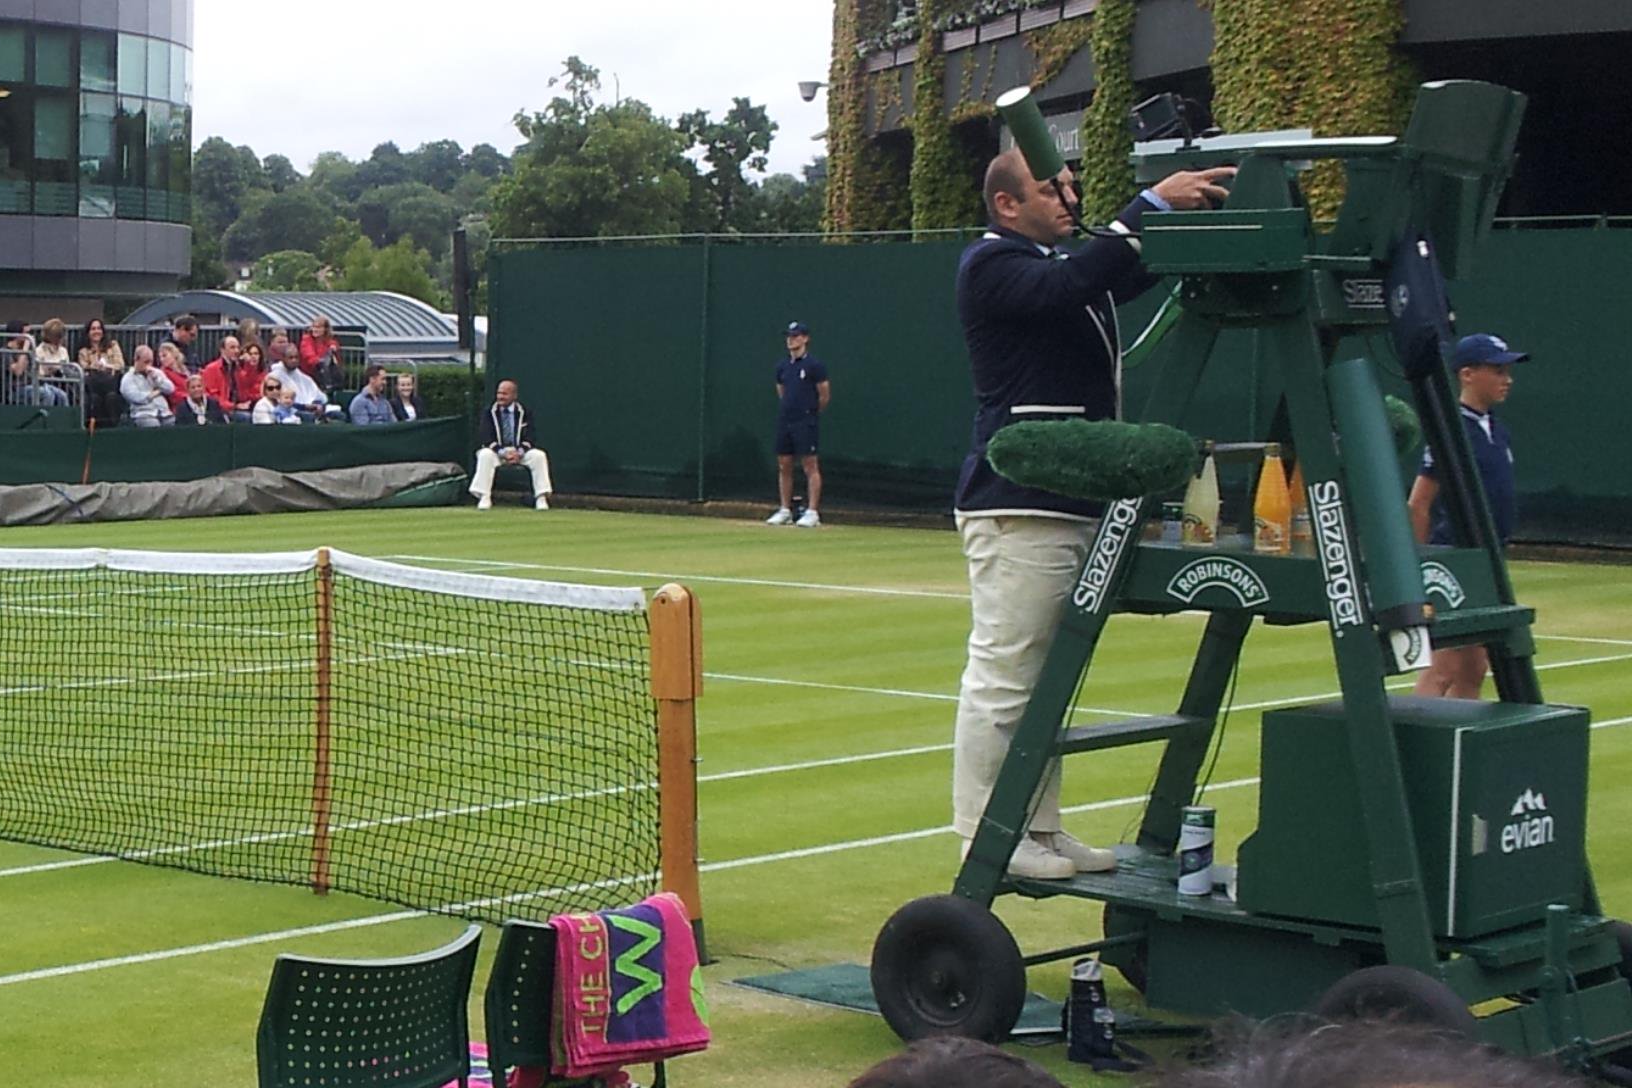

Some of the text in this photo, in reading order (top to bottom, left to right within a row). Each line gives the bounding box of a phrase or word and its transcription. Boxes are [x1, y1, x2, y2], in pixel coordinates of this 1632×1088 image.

[1177, 563, 1260, 598] ROBINSONS
[1314, 481, 1359, 626] Slazenger
[1501, 814, 1554, 853] evian
[607, 914, 662, 1015] W
[581, 971, 605, 1038] THE
